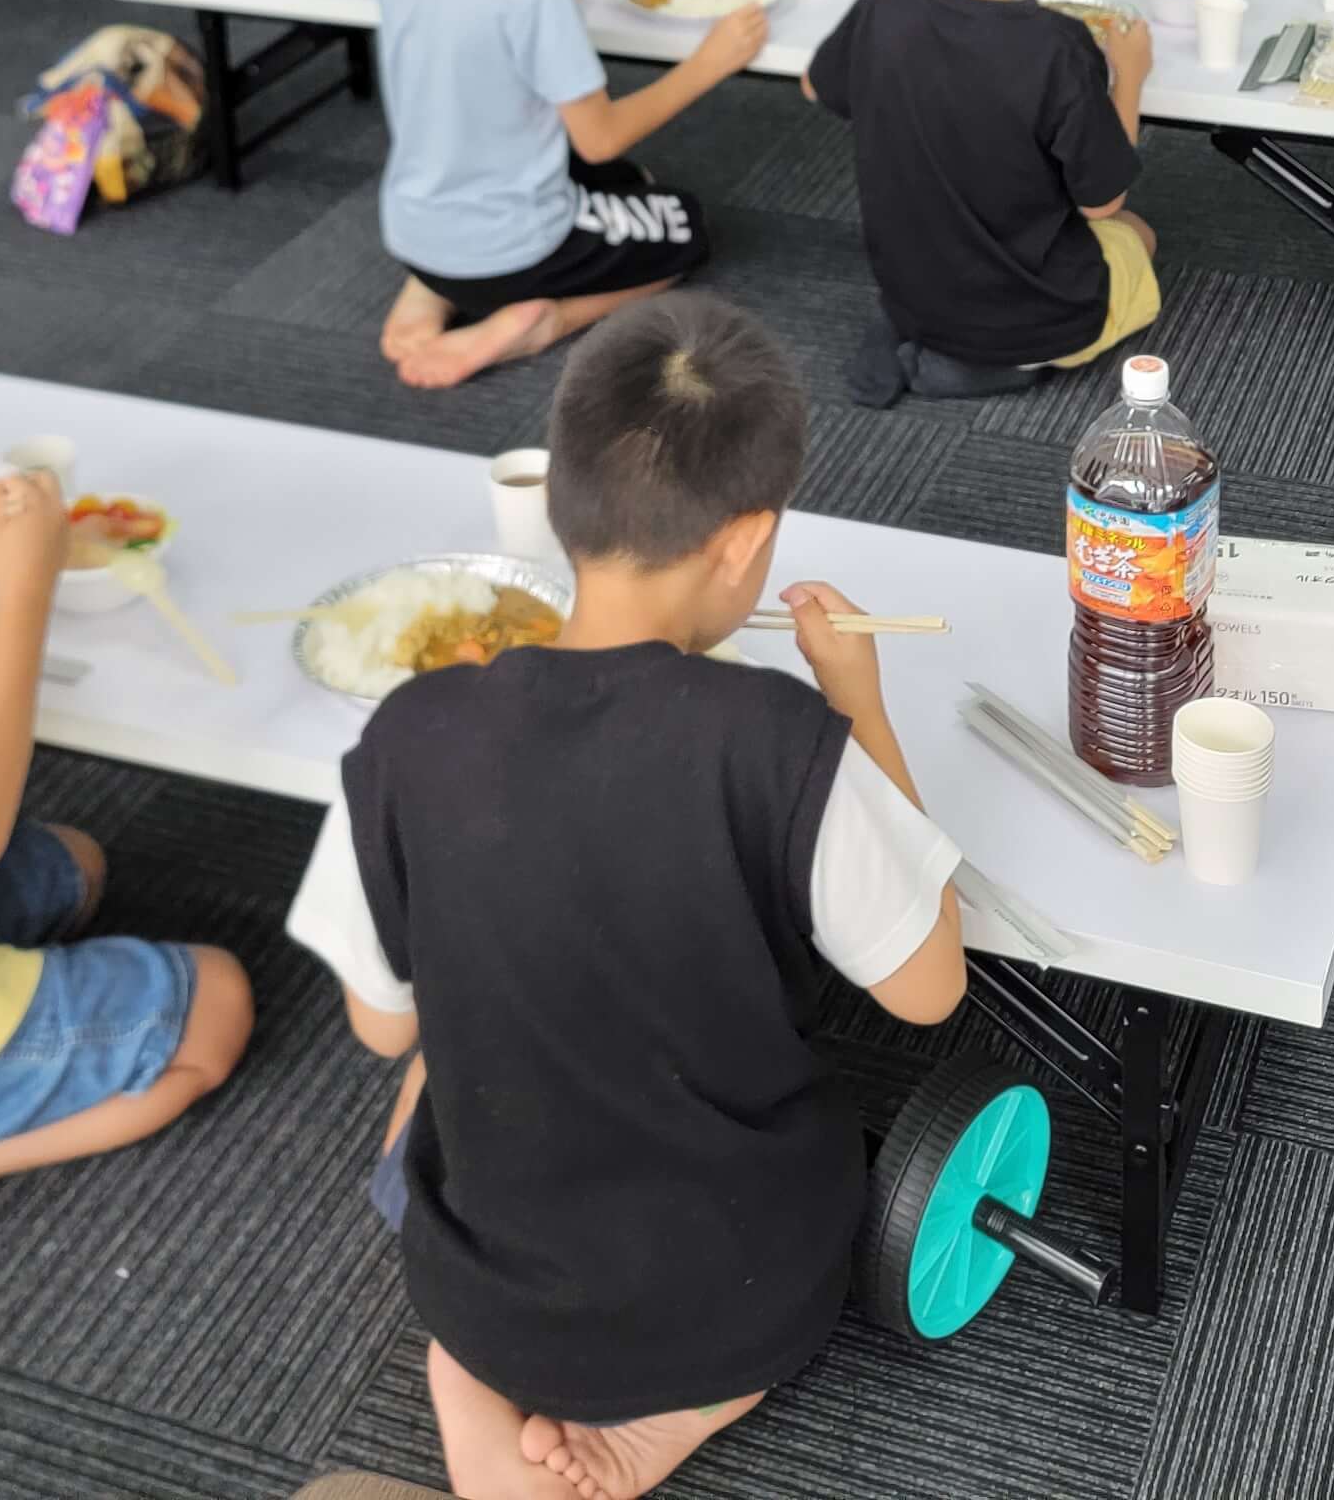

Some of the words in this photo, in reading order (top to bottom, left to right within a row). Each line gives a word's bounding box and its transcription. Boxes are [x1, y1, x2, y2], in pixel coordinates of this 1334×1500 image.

[1074, 534, 1144, 580] むぎ茶
[1260, 690, 1289, 706] 150
